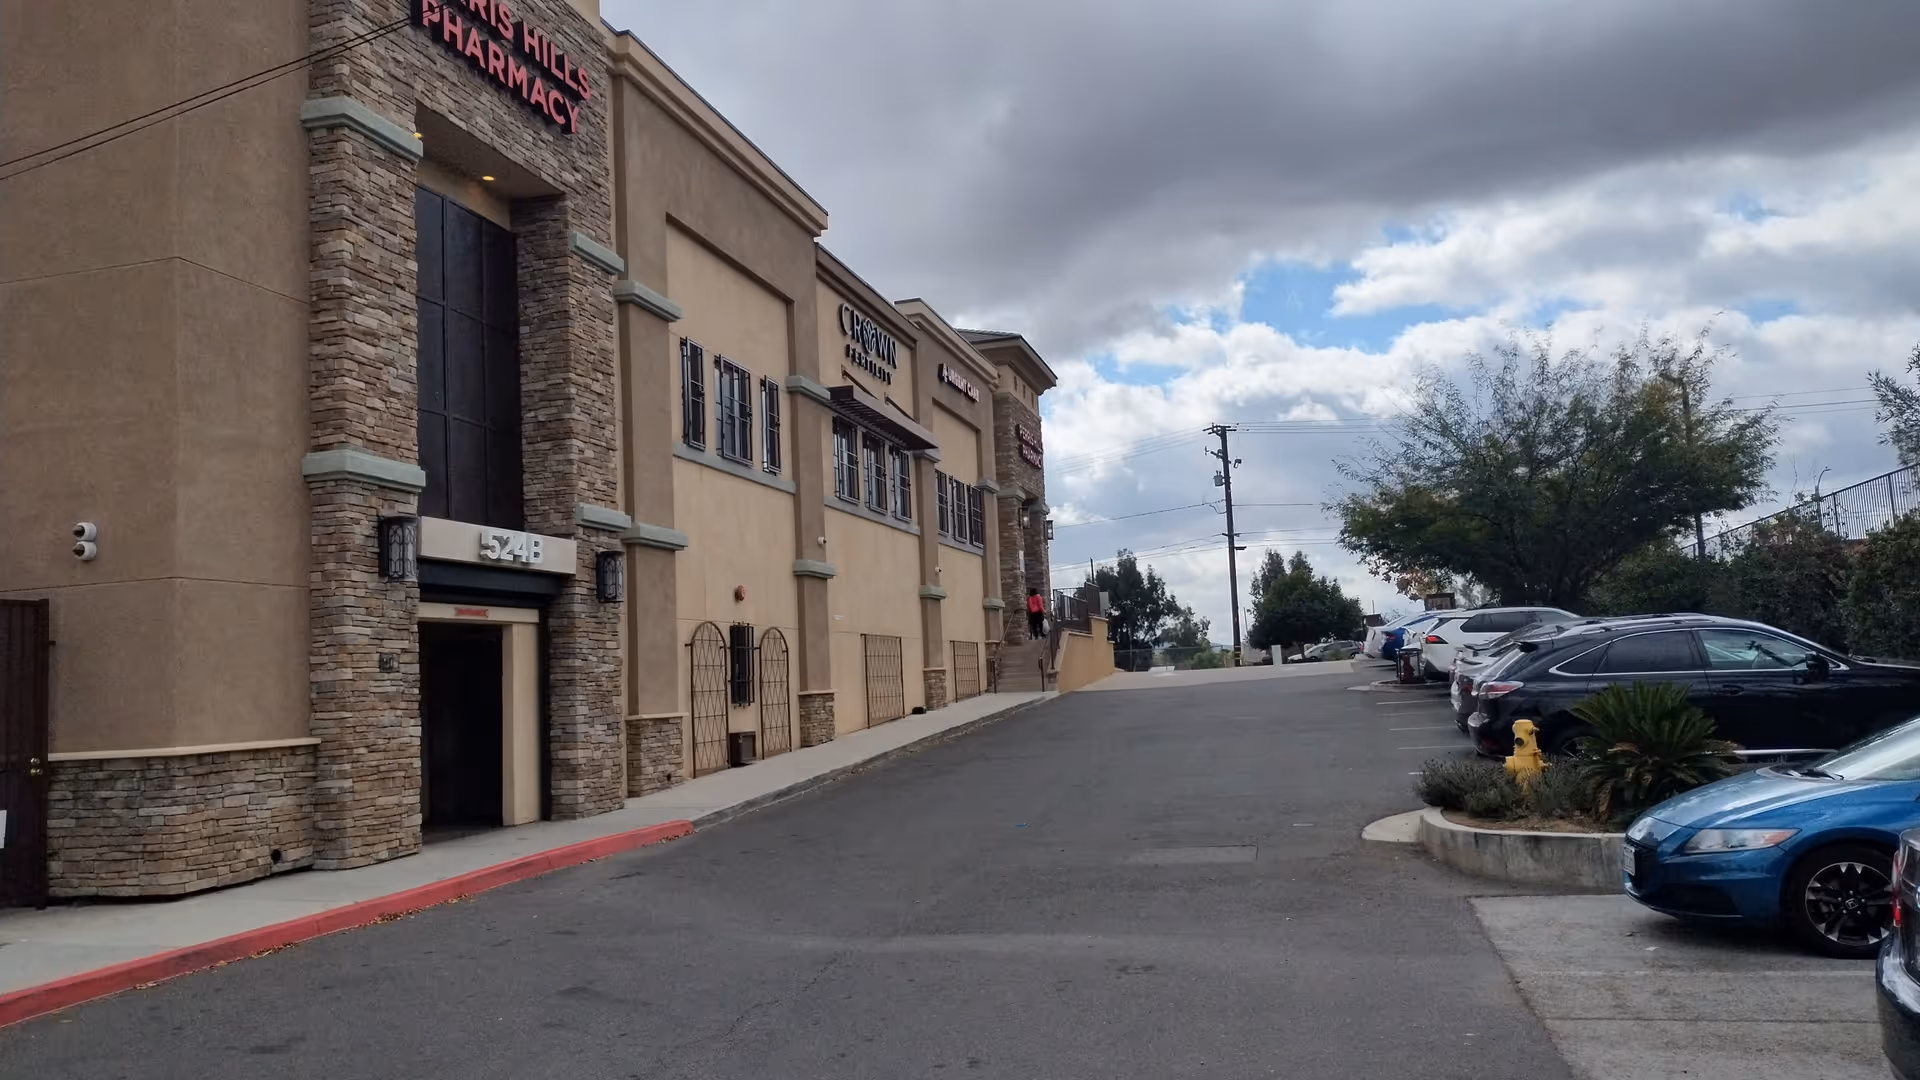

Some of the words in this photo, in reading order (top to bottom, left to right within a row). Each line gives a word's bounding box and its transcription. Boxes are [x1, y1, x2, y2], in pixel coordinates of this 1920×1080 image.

[421, 0, 580, 134] PHARMACY
[521, 21, 592, 101] HILLS
[840, 303, 898, 370] CROWN
